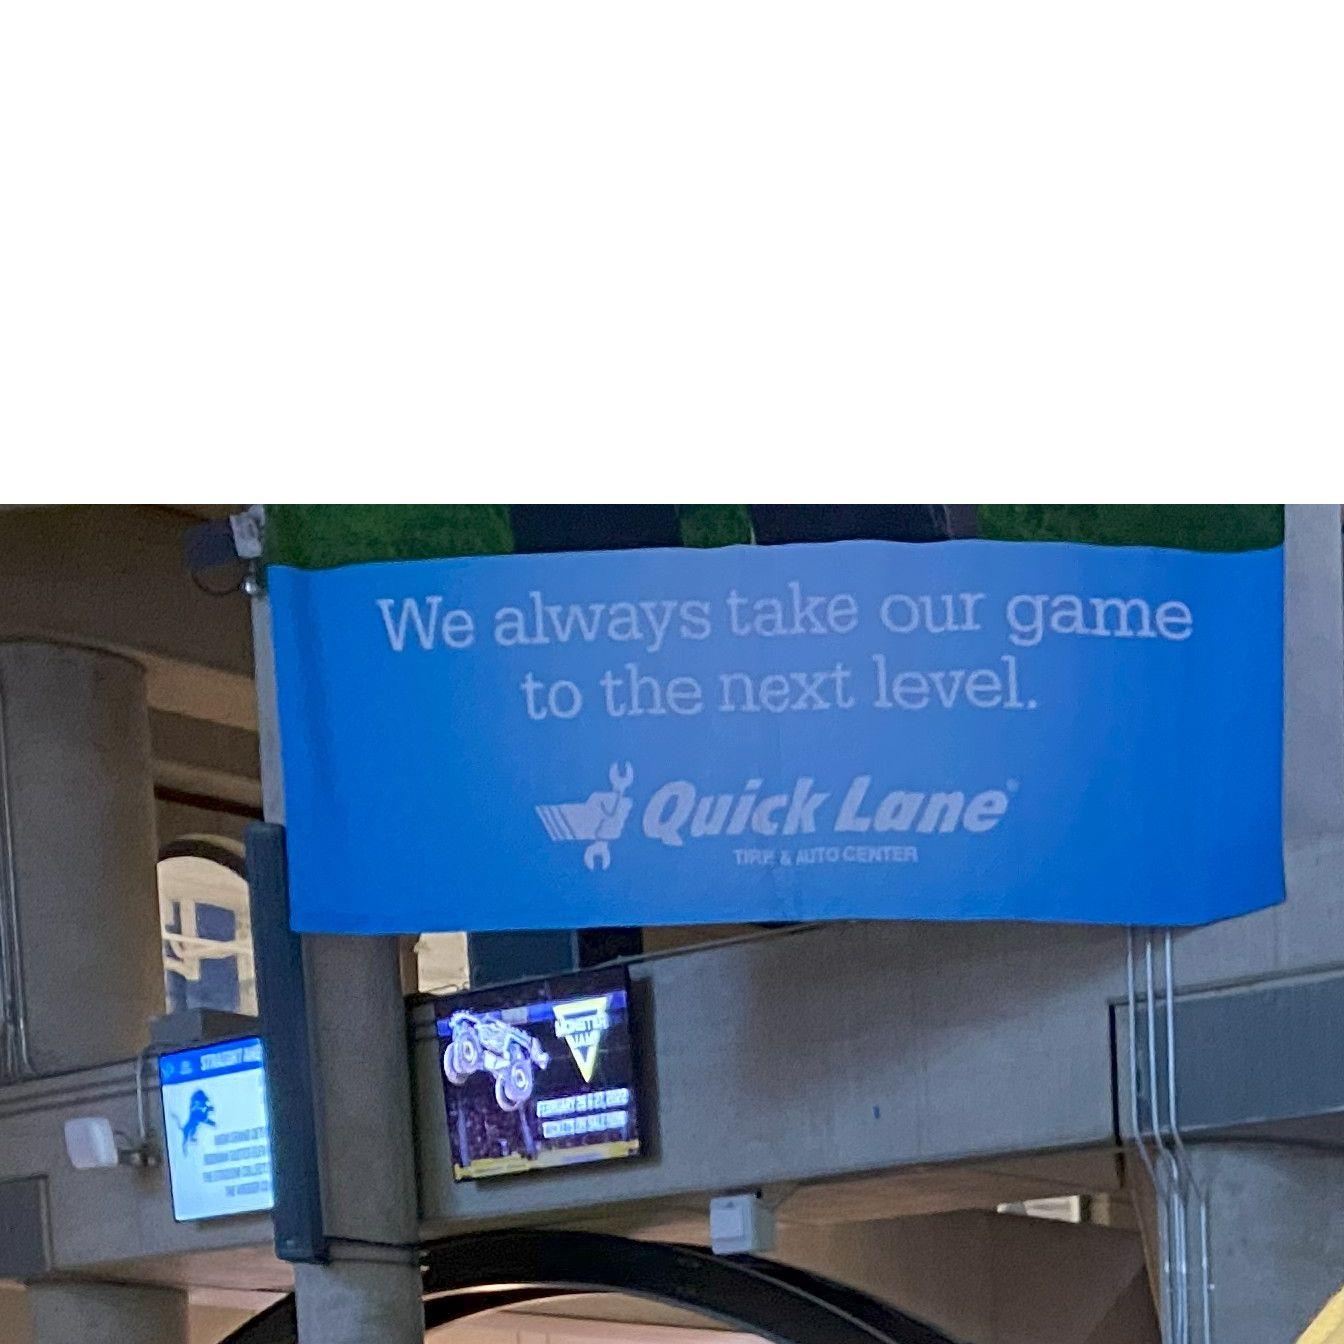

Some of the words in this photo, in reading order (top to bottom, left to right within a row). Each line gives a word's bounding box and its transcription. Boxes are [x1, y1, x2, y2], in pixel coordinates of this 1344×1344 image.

[375, 594, 476, 653] We
[493, 591, 712, 654] always
[728, 582, 860, 638] take
[879, 590, 987, 635] our
[1004, 591, 1196, 648] game
[519, 672, 585, 721] to
[599, 662, 706, 719] the
[718, 660, 853, 714] next
[871, 655, 1040, 714] level.
[640, 776, 818, 846] Quick
[832, 774, 1009, 834] Lane
[796, 847, 840, 865] AUTO
[841, 845, 920, 864] CENTER
